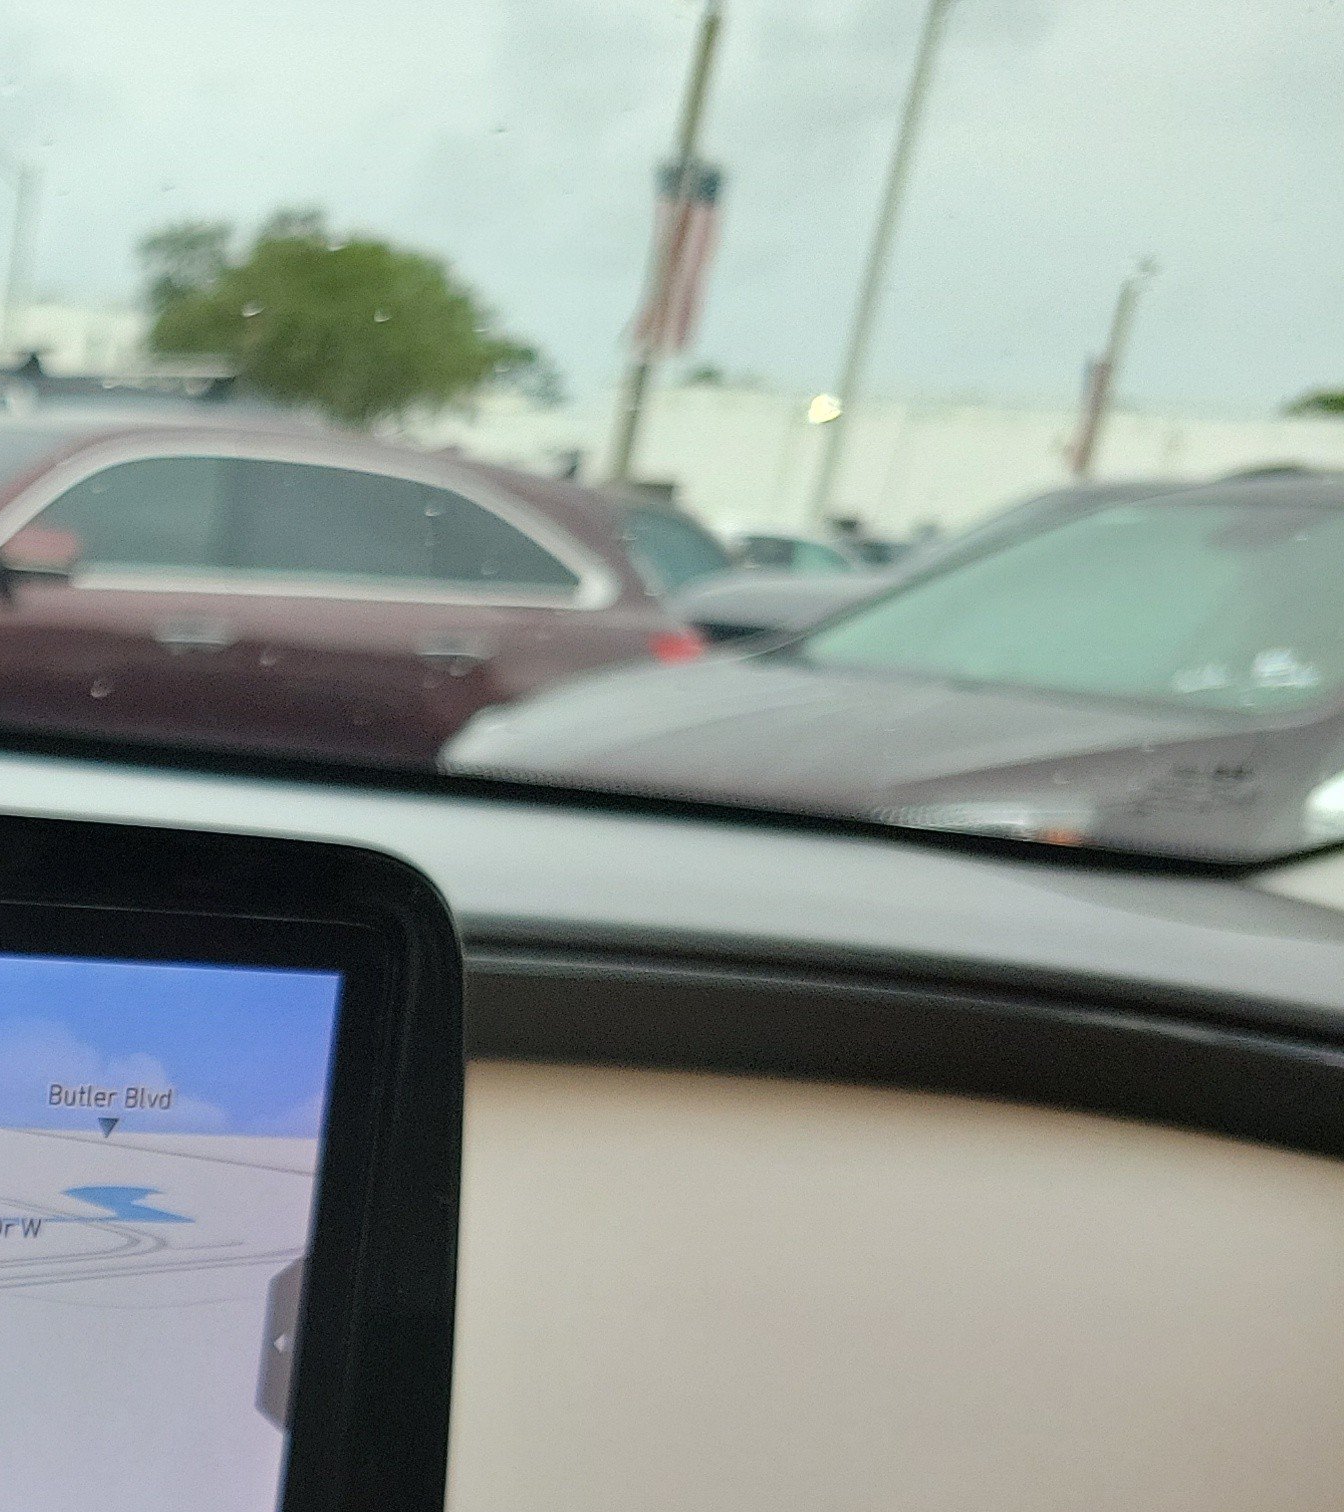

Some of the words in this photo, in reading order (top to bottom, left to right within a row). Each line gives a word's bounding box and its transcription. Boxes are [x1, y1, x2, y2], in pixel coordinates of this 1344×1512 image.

[48, 1084, 117, 1109] Butler
[125, 1086, 173, 1110] Blvd
[21, 1218, 42, 1239] W
